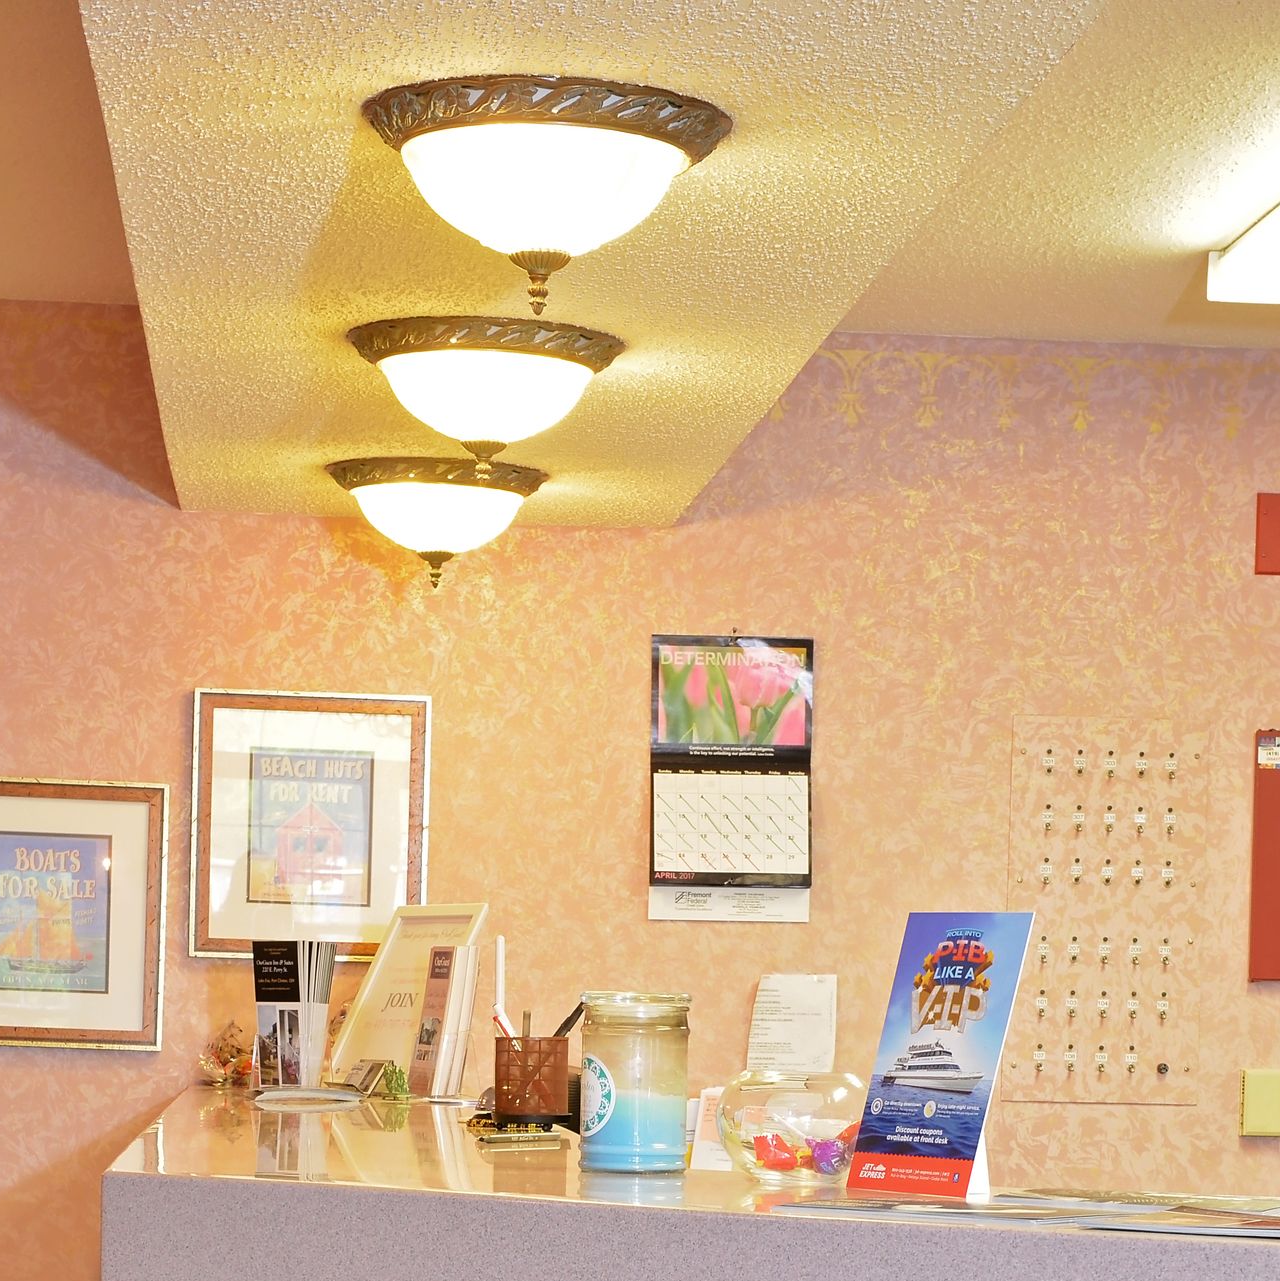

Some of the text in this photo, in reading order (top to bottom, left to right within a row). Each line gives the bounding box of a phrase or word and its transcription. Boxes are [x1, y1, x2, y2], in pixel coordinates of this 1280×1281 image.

[660, 651, 806, 667] DETERMINAON
[260, 756, 366, 780] BEACH HUTS
[269, 782, 353, 804] FOR RENT
[14, 847, 81, 873] BOATS
[679, 872, 695, 880] 2017
[46, 876, 97, 900] SALE
[946, 930, 982, 938] ROLL INTO
[933, 965, 975, 980] LIKE A
[380, 992, 419, 1013] JOIN
[895, 1125, 943, 1136] Discount coupons
[886, 1135, 914, 1143] available
[920, 1136, 934, 1144] front
[934, 1137, 949, 1145] desk
[862, 1163, 875, 1171] JET
[859, 1171, 886, 1179] EXPRESS
